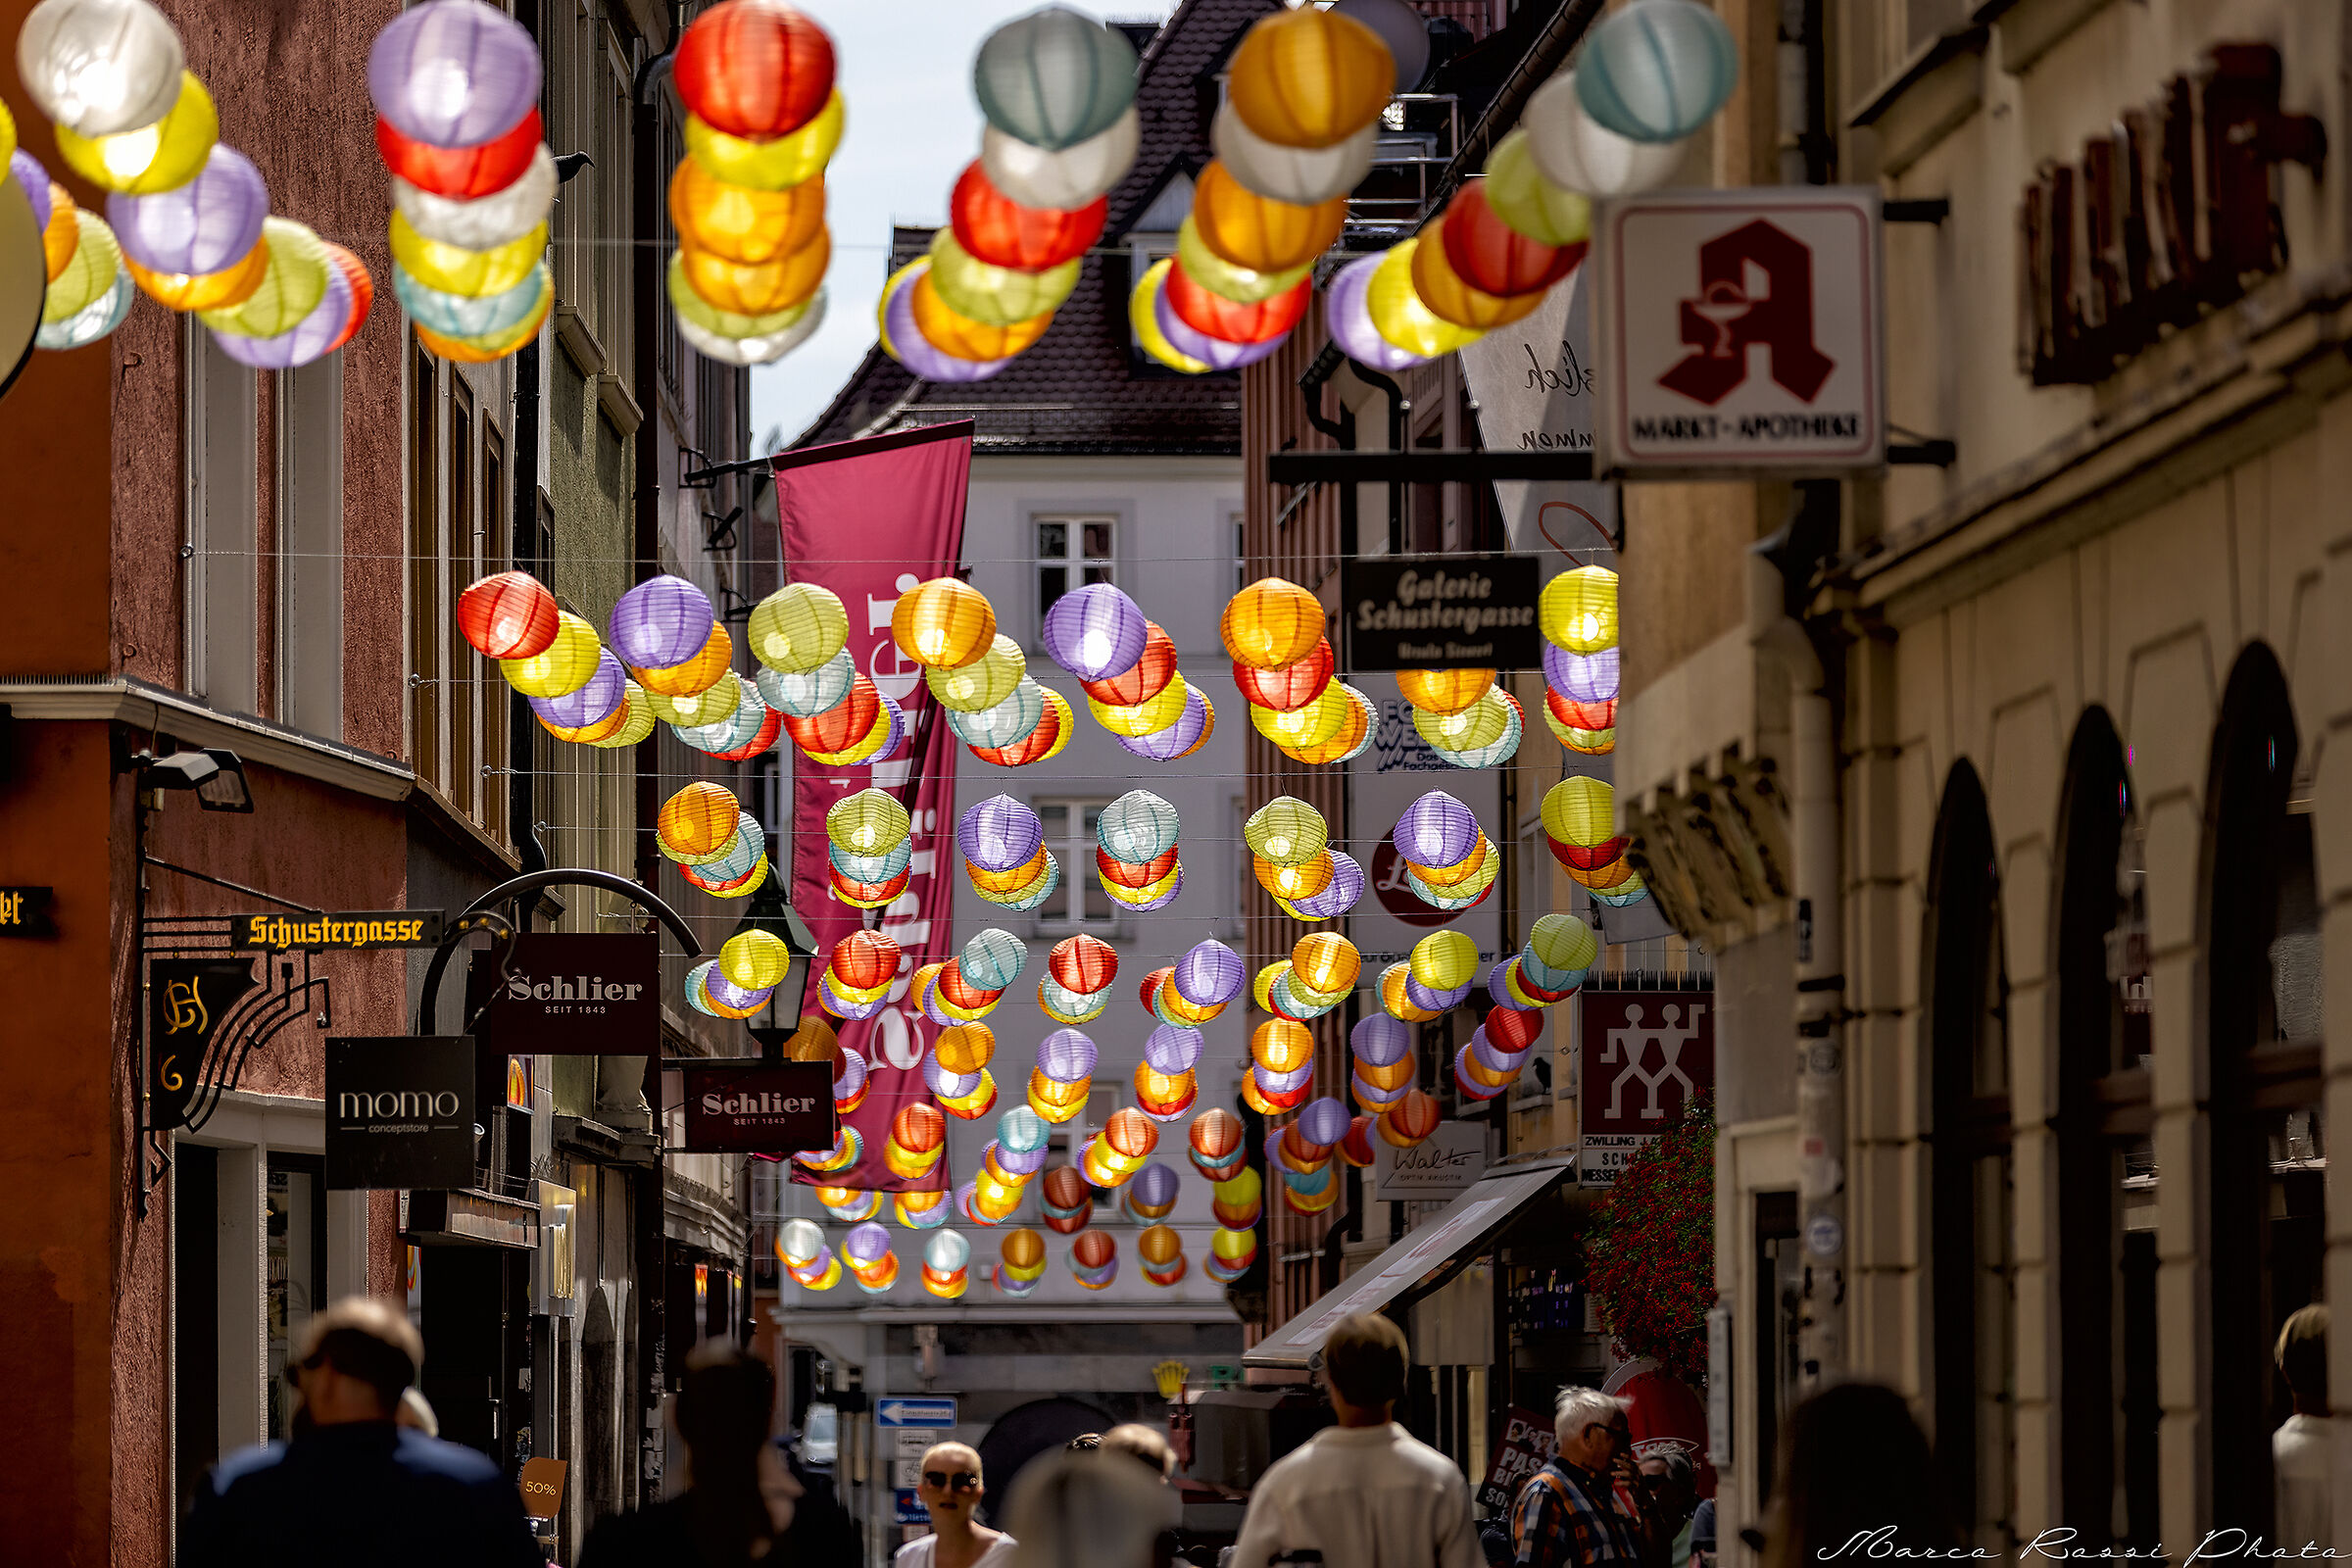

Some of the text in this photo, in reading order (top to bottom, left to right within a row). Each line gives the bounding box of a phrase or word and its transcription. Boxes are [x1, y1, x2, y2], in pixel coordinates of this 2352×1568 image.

[1396, 569, 1493, 607] Galerie
[1356, 599, 1535, 635] Schustergasse
[248, 915, 424, 950] Schustergasse
[509, 975, 642, 1001] Schlier
[545, 1005, 606, 1014] SEIT 1843
[161, 1054, 183, 1092] 6
[339, 1091, 460, 1118] momo
[702, 1093, 815, 1116] Schlier
[368, 1124, 429, 1134] conceptstore
[733, 1116, 786, 1126] SEIT 1843
[1585, 1137, 1636, 1146] ZWILLING
[1395, 1146, 1482, 1170] Walter
[525, 1481, 557, 1496] 50%
